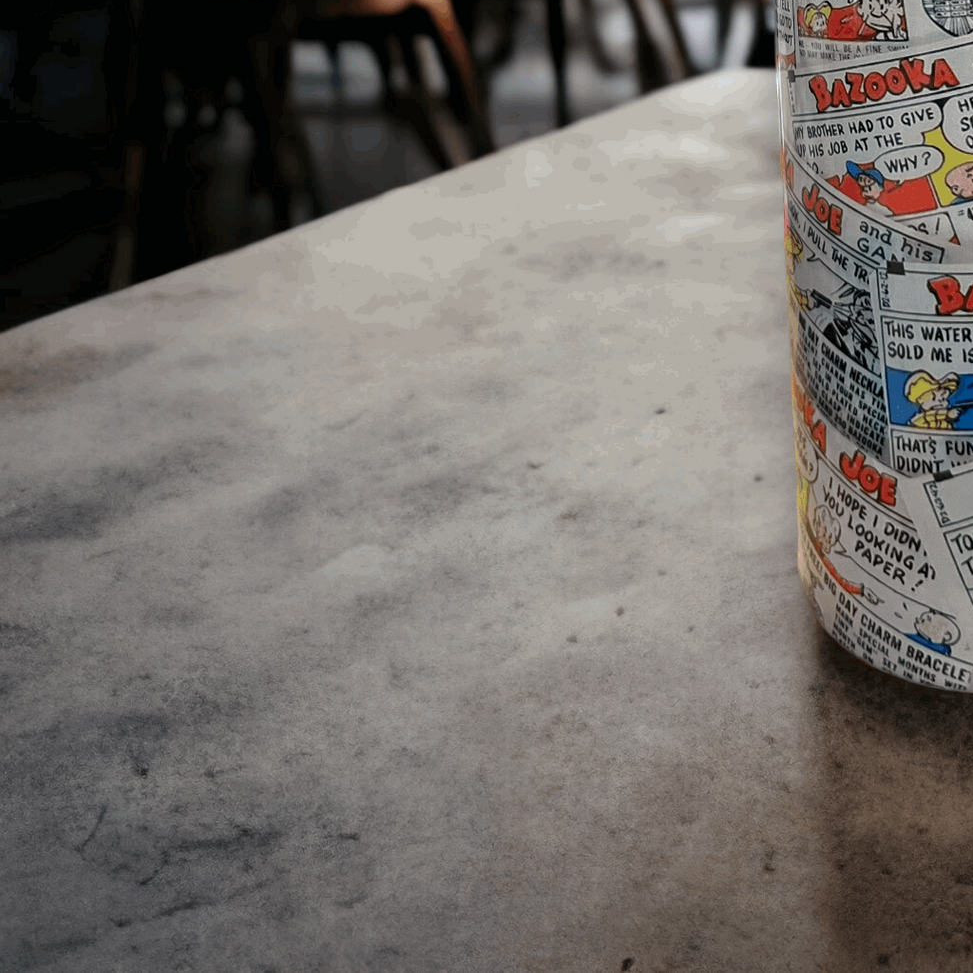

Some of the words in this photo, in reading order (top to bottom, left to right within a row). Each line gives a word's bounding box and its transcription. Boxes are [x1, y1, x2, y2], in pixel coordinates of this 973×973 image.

[844, 44, 852, 53] BE
[865, 44, 882, 53] FINE
[809, 57, 961, 113] BAZOOKA
[807, 121, 844, 139] BROTHER
[849, 119, 873, 134] HAD
[876, 115, 894, 130] TO
[901, 107, 934, 126] GIVE
[809, 142, 824, 158] HIS
[828, 139, 848, 154] JOB
[854, 137, 870, 152] AT
[874, 132, 904, 148] THE
[802, 183, 843, 236] JOE
[859, 220, 893, 246] and
[900, 237, 934, 262] his
[807, 225, 828, 255] PULL
[831, 245, 850, 272] THE
[884, 320, 915, 341] THIS
[921, 325, 972, 343] WATER
[821, 342, 847, 374] CHARM
[887, 341, 924, 361] SOLD
[931, 348, 953, 364] ME
[847, 413, 886, 446] INDICATE
[839, 449, 898, 507] JOE
[836, 484, 867, 520] HOPE
[823, 485, 845, 517] YOU
[848, 516, 914, 571] LOOKING
[824, 573, 837, 596] BIG
[839, 592, 858, 618] DAY
[860, 613, 902, 652] CHARM
[859, 628, 890, 657] SPECIAL
[898, 657, 937, 683] MONTHS
